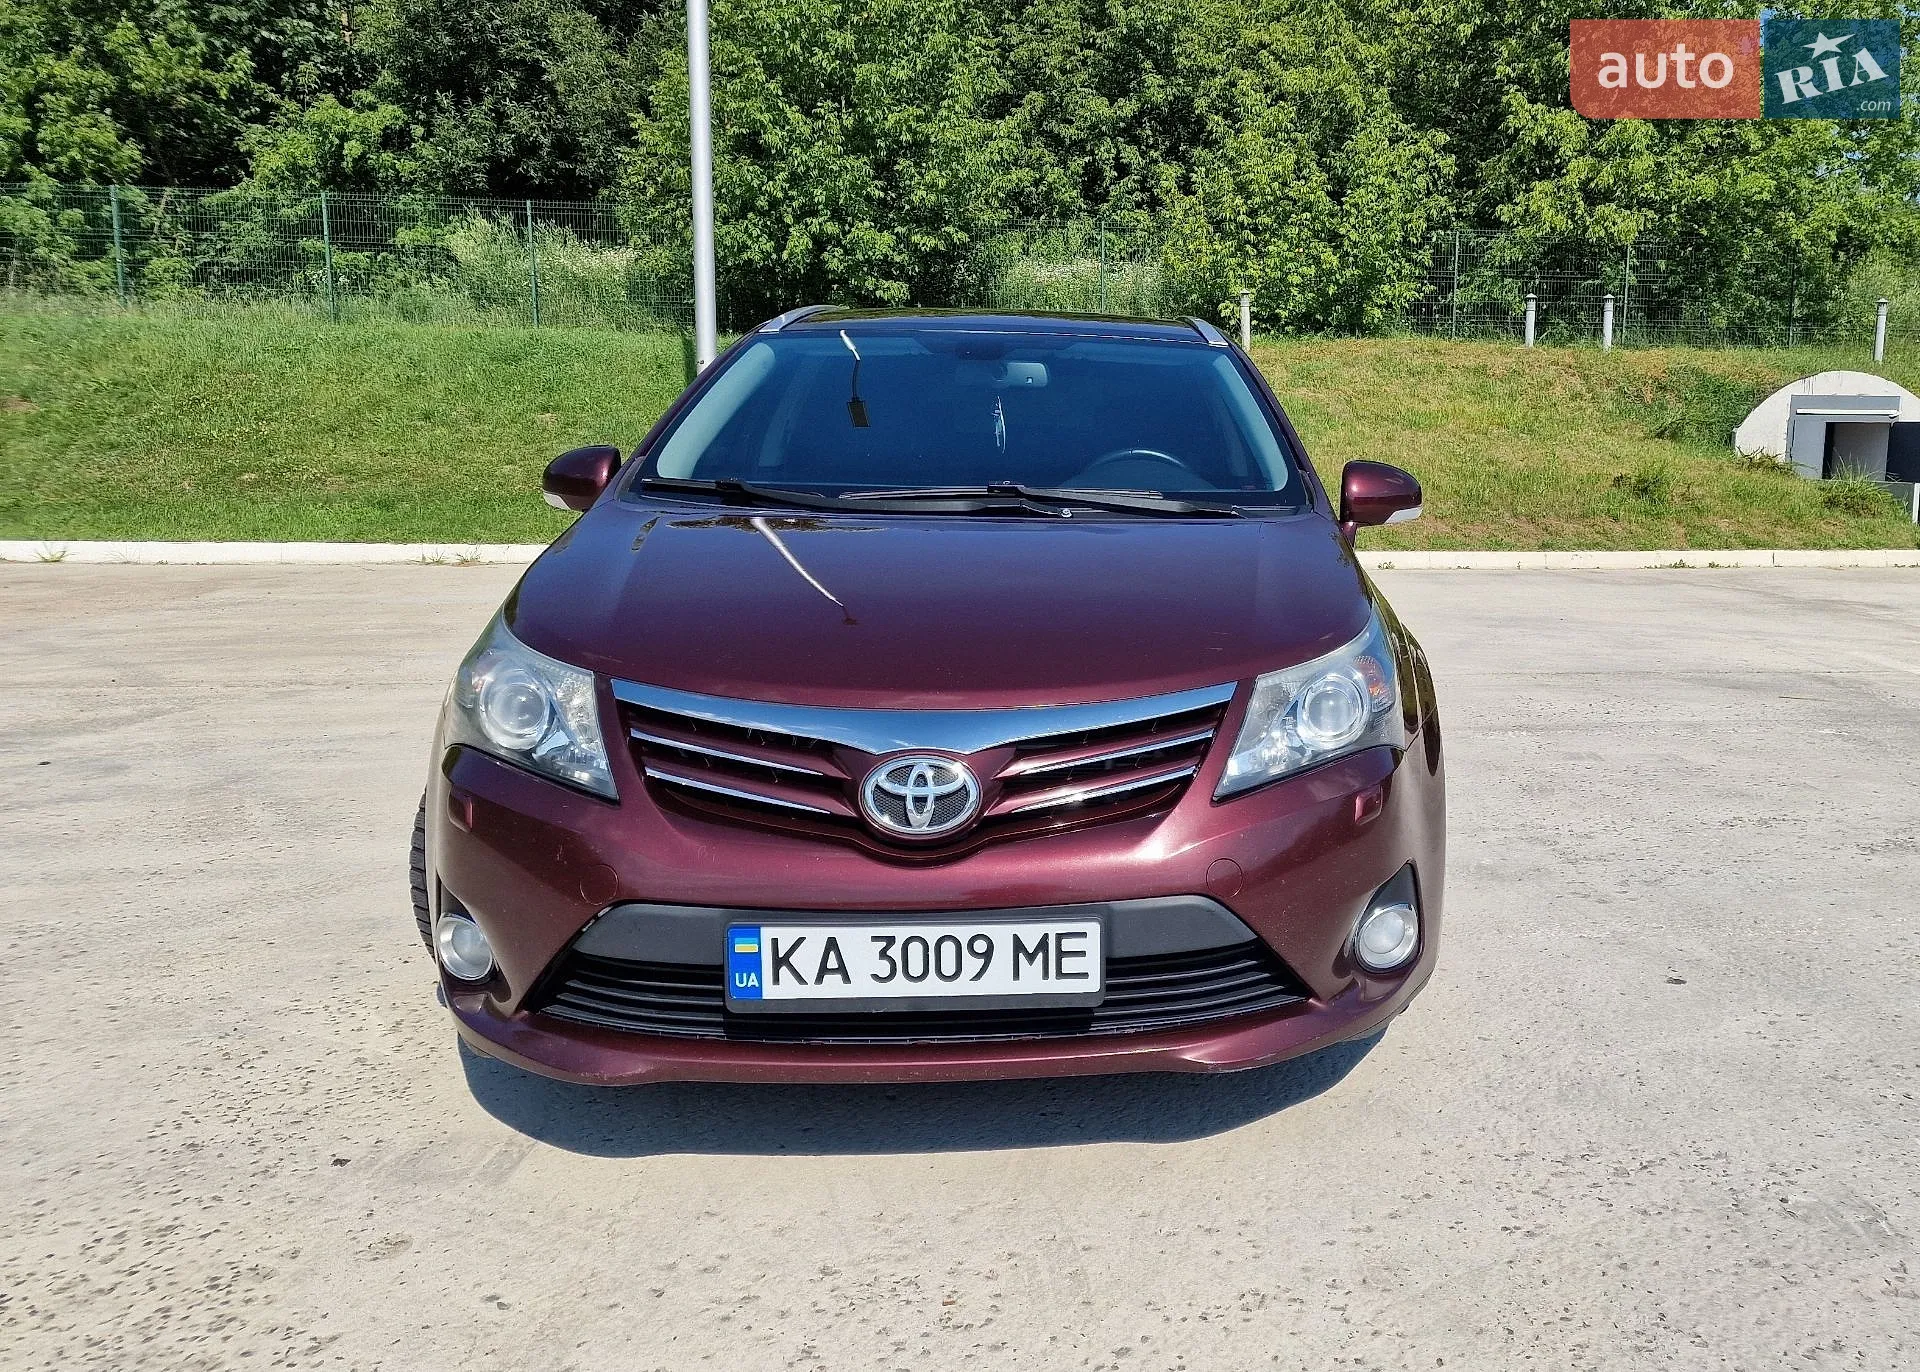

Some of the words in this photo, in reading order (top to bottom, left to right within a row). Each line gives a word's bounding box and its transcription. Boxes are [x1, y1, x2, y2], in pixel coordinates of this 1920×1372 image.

[770, 936, 852, 986] KA
[870, 933, 995, 983] 3009
[1011, 931, 1089, 981] ME
[735, 972, 759, 988] UA
